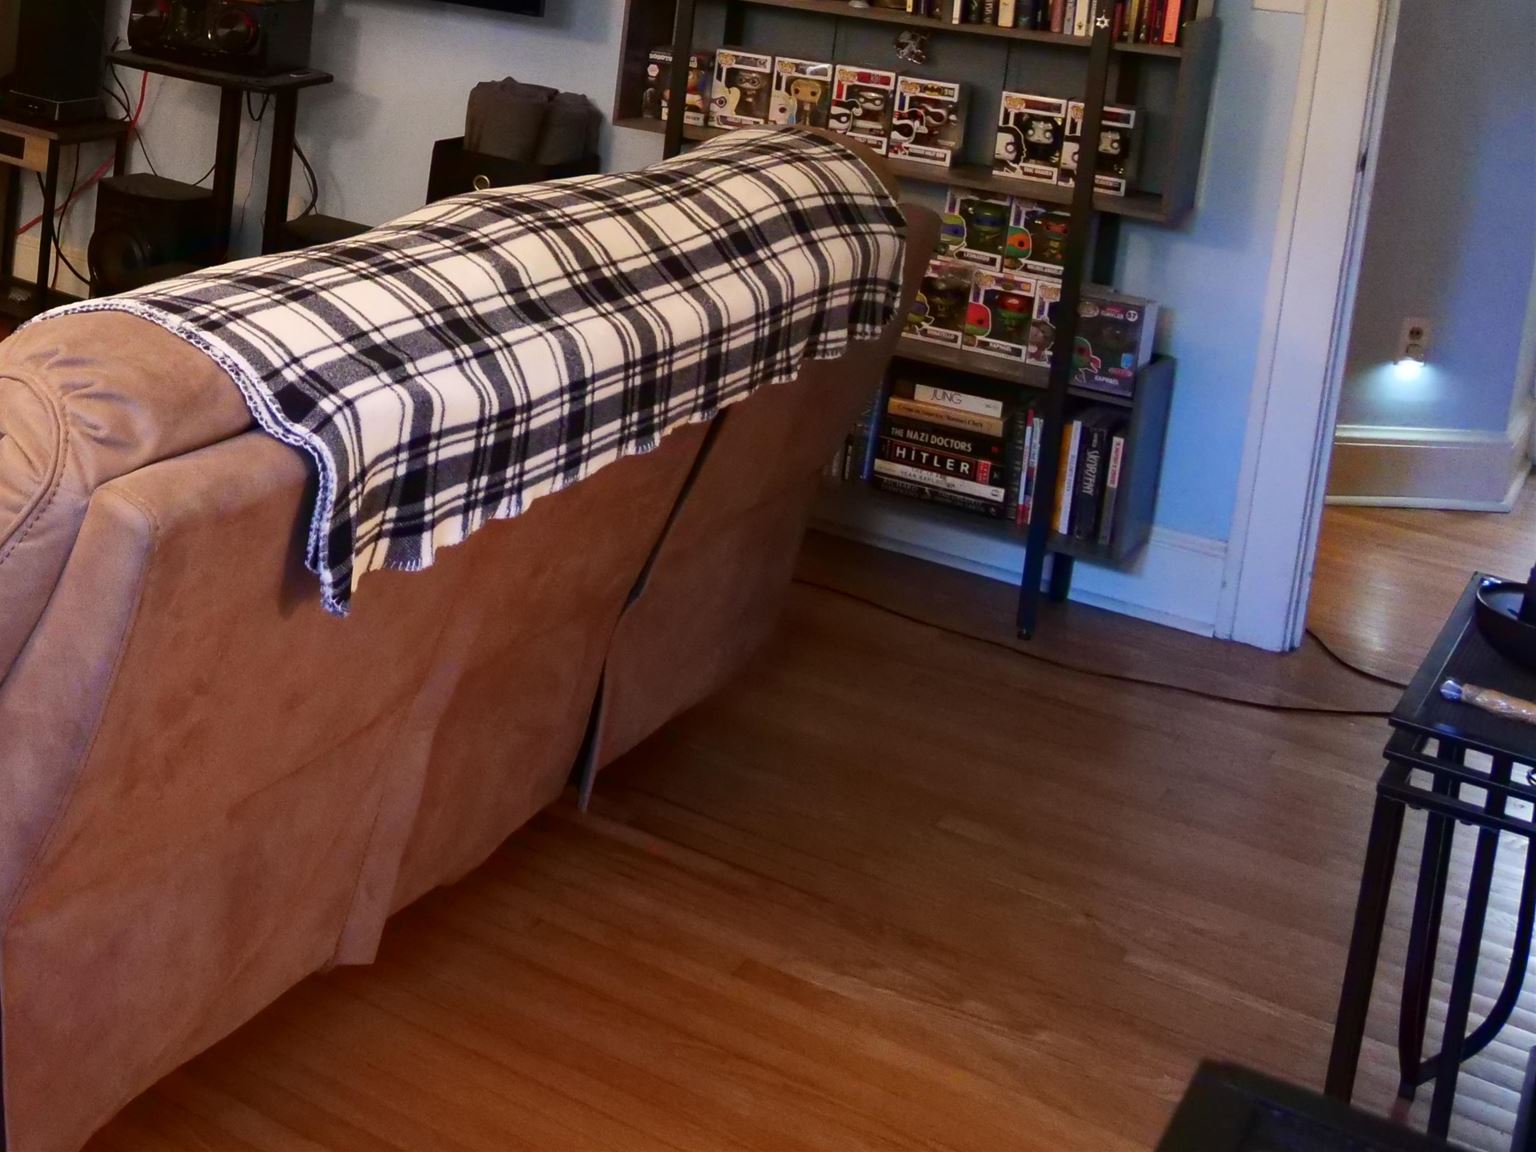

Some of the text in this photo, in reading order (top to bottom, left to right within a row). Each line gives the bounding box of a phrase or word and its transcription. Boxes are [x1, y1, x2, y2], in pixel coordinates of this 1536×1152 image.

[930, 387, 963, 405] JUNG
[891, 427, 973, 453] THE NAZI DOCTORS
